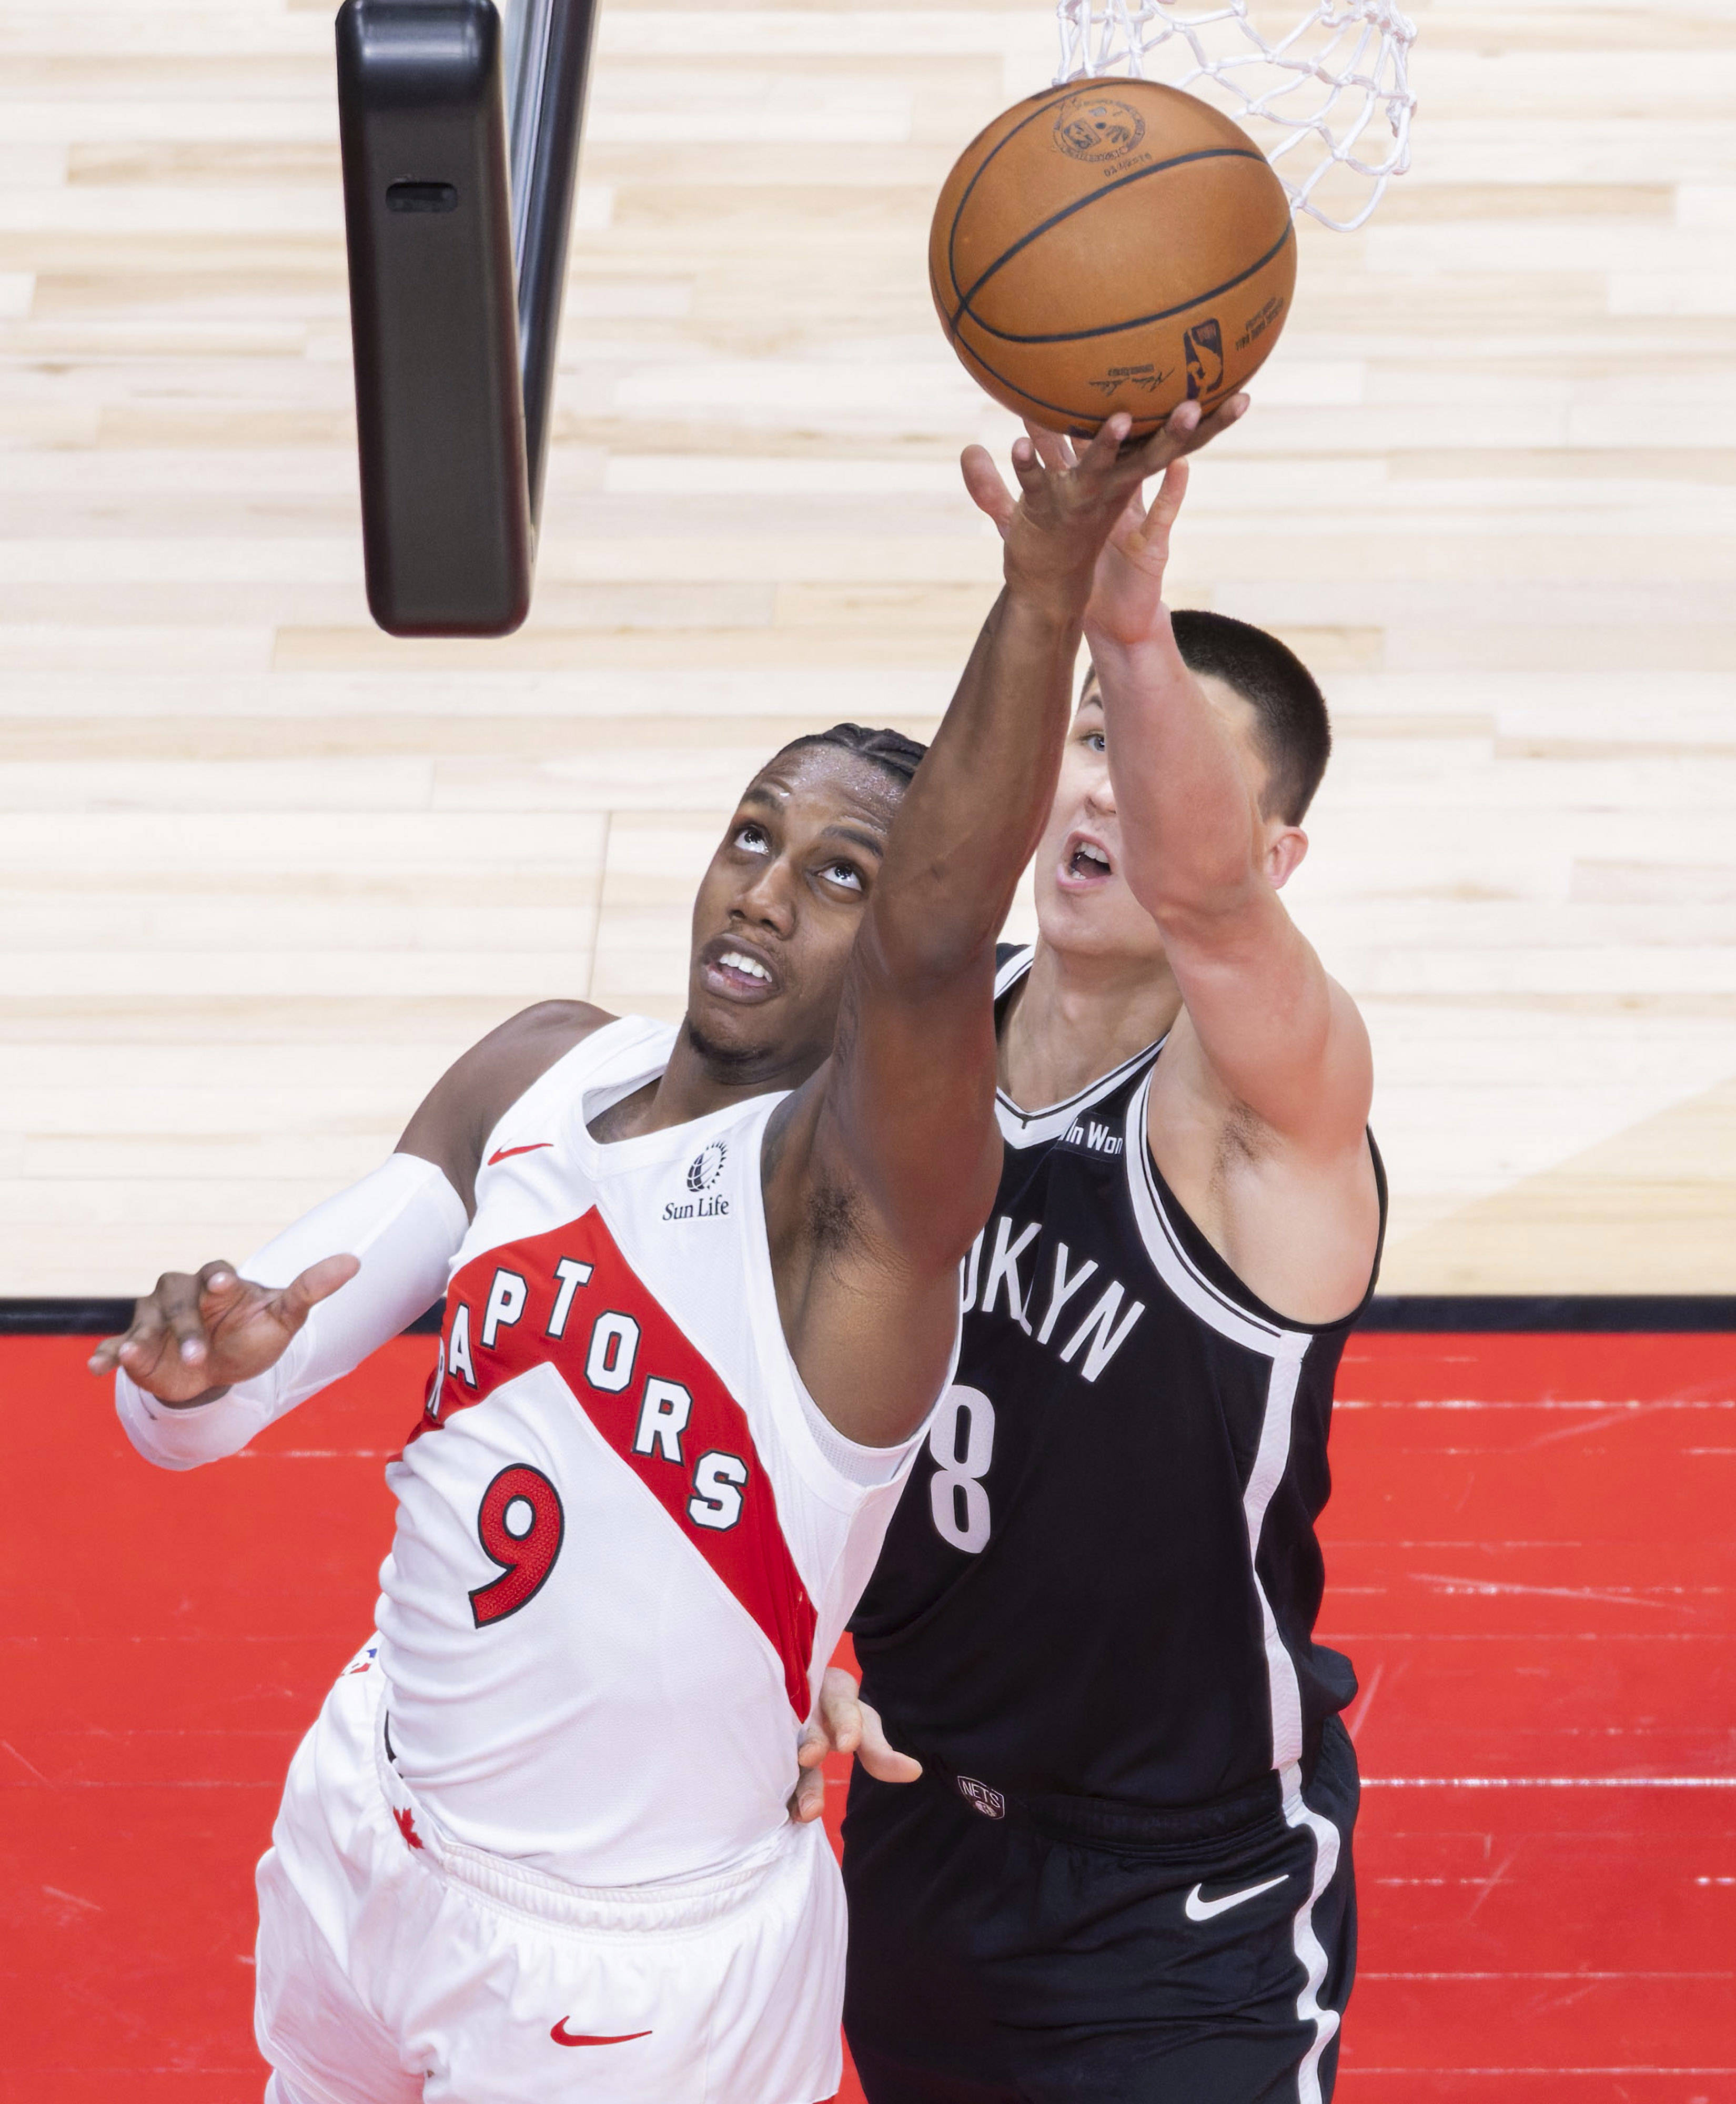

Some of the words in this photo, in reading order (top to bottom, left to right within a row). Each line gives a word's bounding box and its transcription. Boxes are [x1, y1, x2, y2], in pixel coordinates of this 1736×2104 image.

[662, 1202, 694, 1221] Sun
[697, 1194, 729, 1217] Life
[930, 1384, 995, 1554] 8
[468, 1463, 565, 1629] 9
[962, 1780, 1001, 1808] NETS
